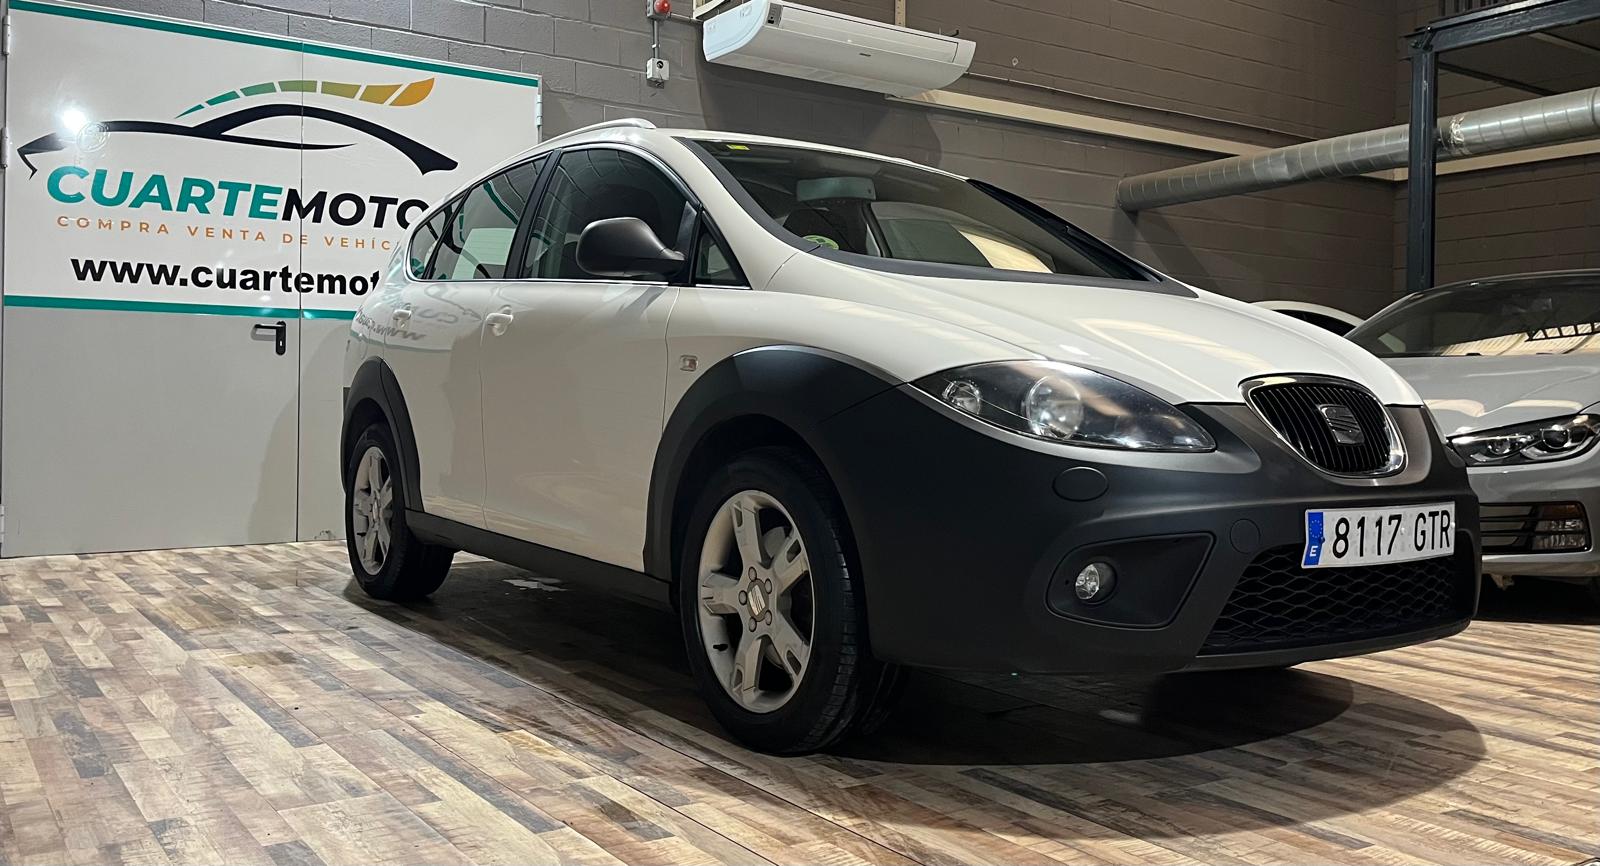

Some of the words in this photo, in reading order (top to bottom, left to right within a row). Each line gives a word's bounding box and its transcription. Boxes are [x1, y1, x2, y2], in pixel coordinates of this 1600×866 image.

[47, 165, 430, 230] CUARTEMOTO
[57, 215, 169, 234] COMPRA
[186, 225, 266, 242] VENTA
[282, 233, 309, 245] DE
[70, 258, 380, 296] www.cuartemot
[1309, 545, 1319, 557] E
[1332, 513, 1402, 559] 8117
[1414, 509, 1451, 552] GTR
